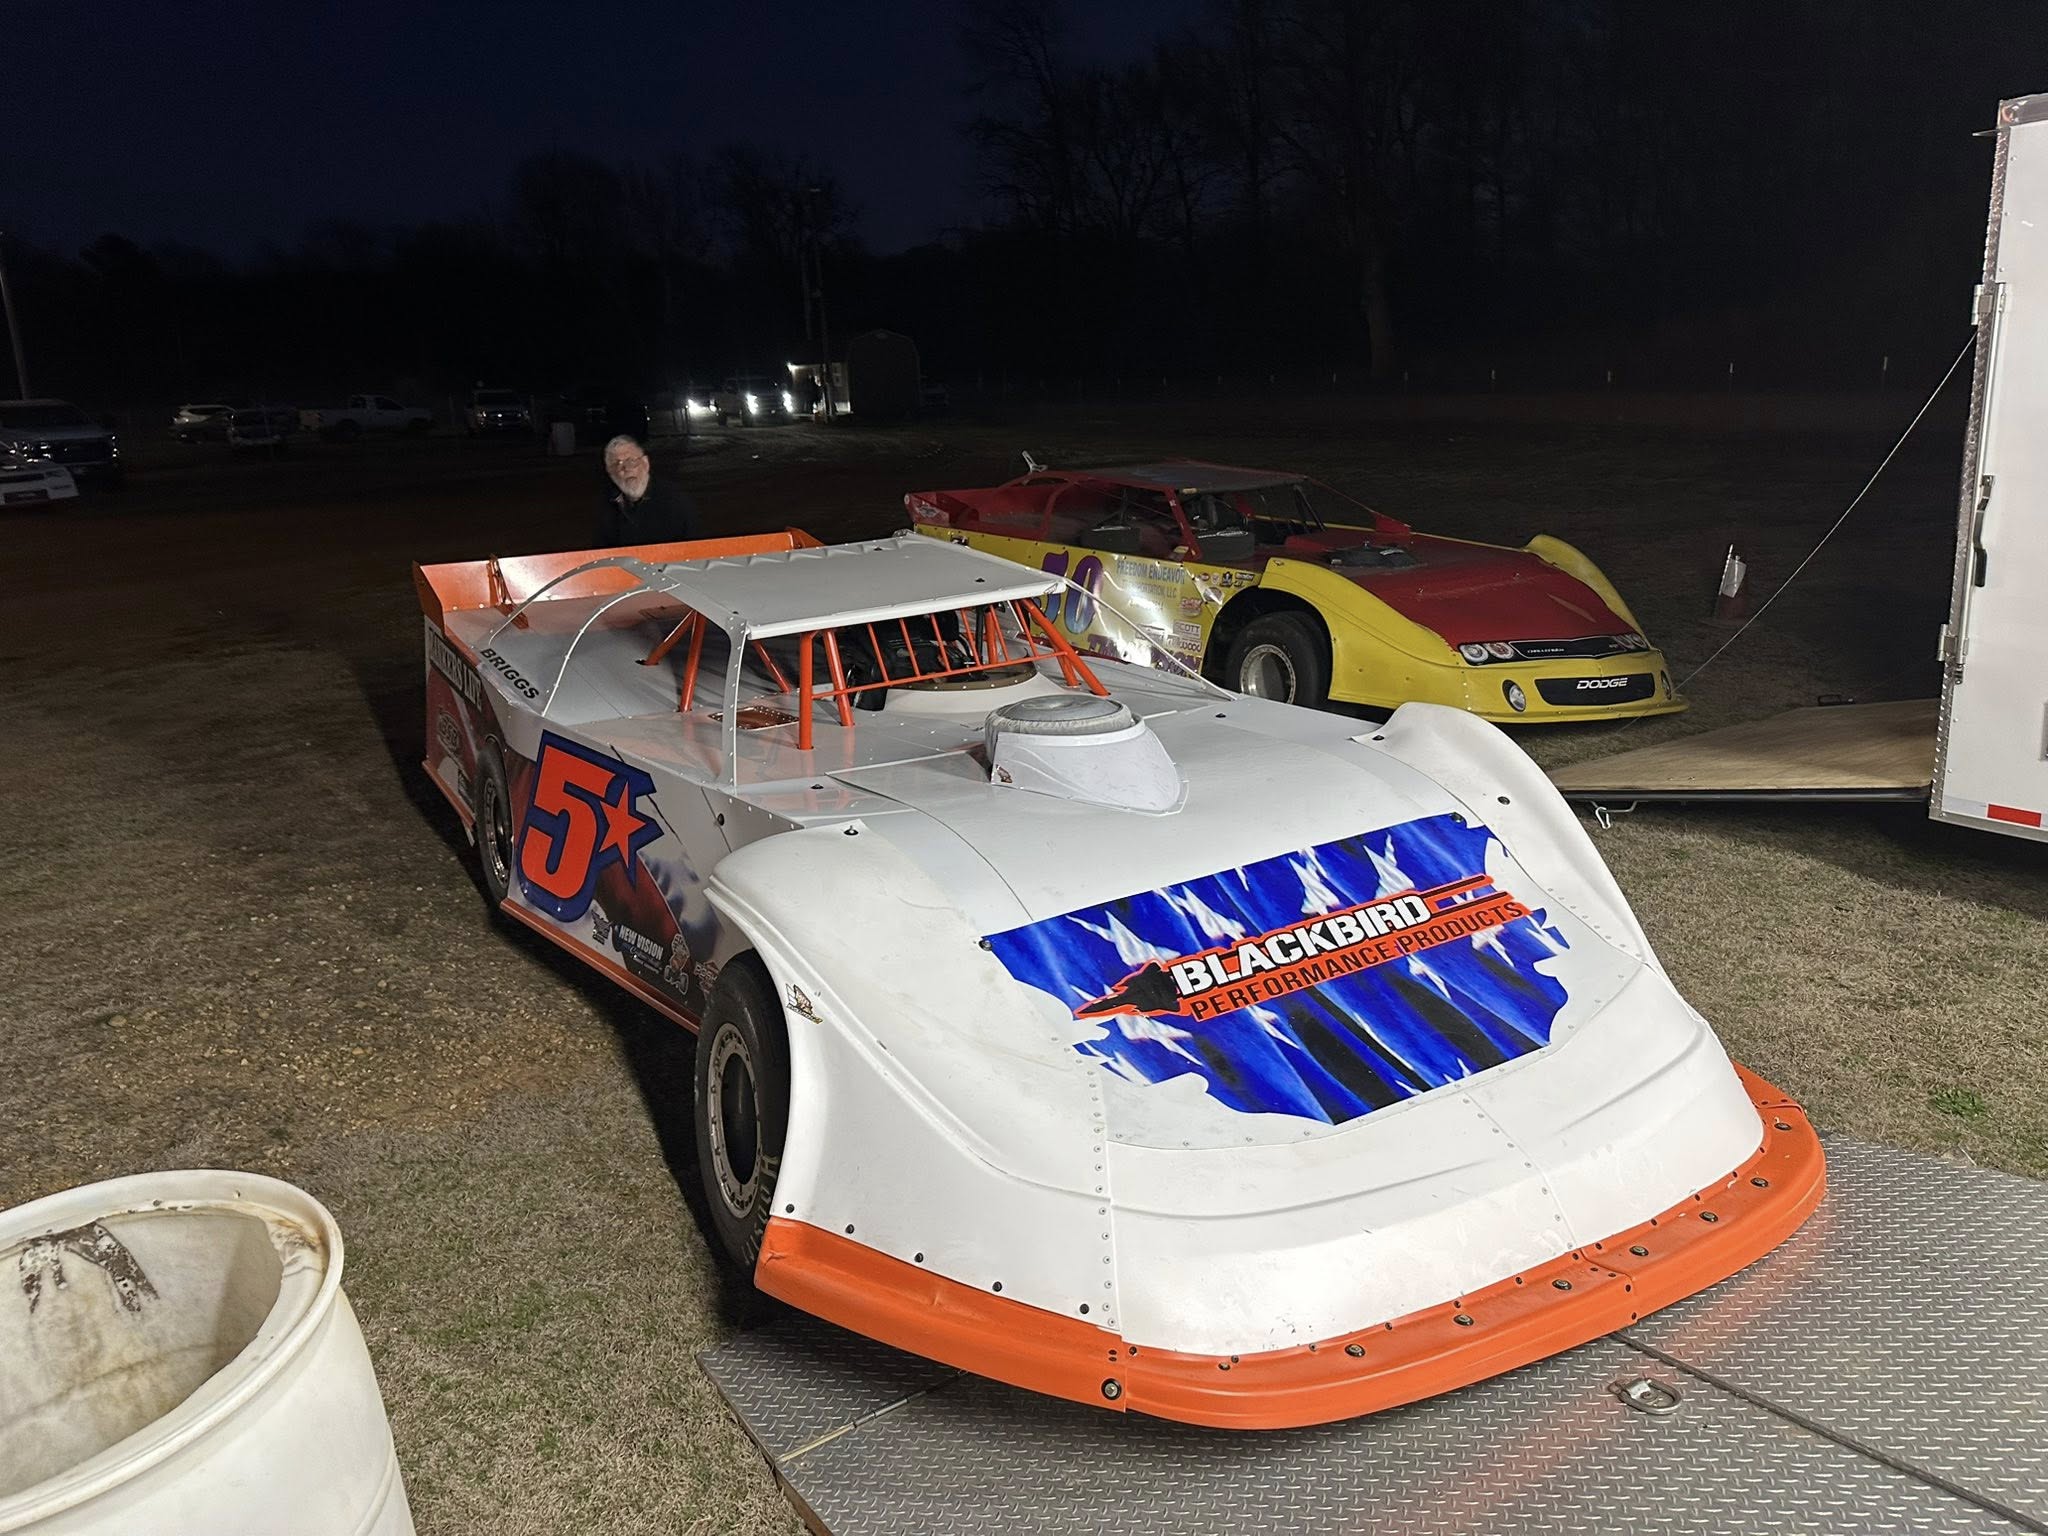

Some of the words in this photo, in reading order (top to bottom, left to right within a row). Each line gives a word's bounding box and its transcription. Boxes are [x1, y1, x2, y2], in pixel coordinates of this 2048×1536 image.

[1117, 560, 1148, 578] FREEDOM
[1149, 564, 1185, 585] ENDEAVOR
[480, 647, 540, 700] BRIGGS
[1576, 677, 1628, 690] DODGE
[619, 923, 639, 946] NEW
[637, 933, 664, 961] VISION
[1170, 895, 1432, 997] BLACKBIRD
[1190, 940, 1391, 1021] PERFORMANCE
[1395, 902, 1524, 955] PRODUCTS
